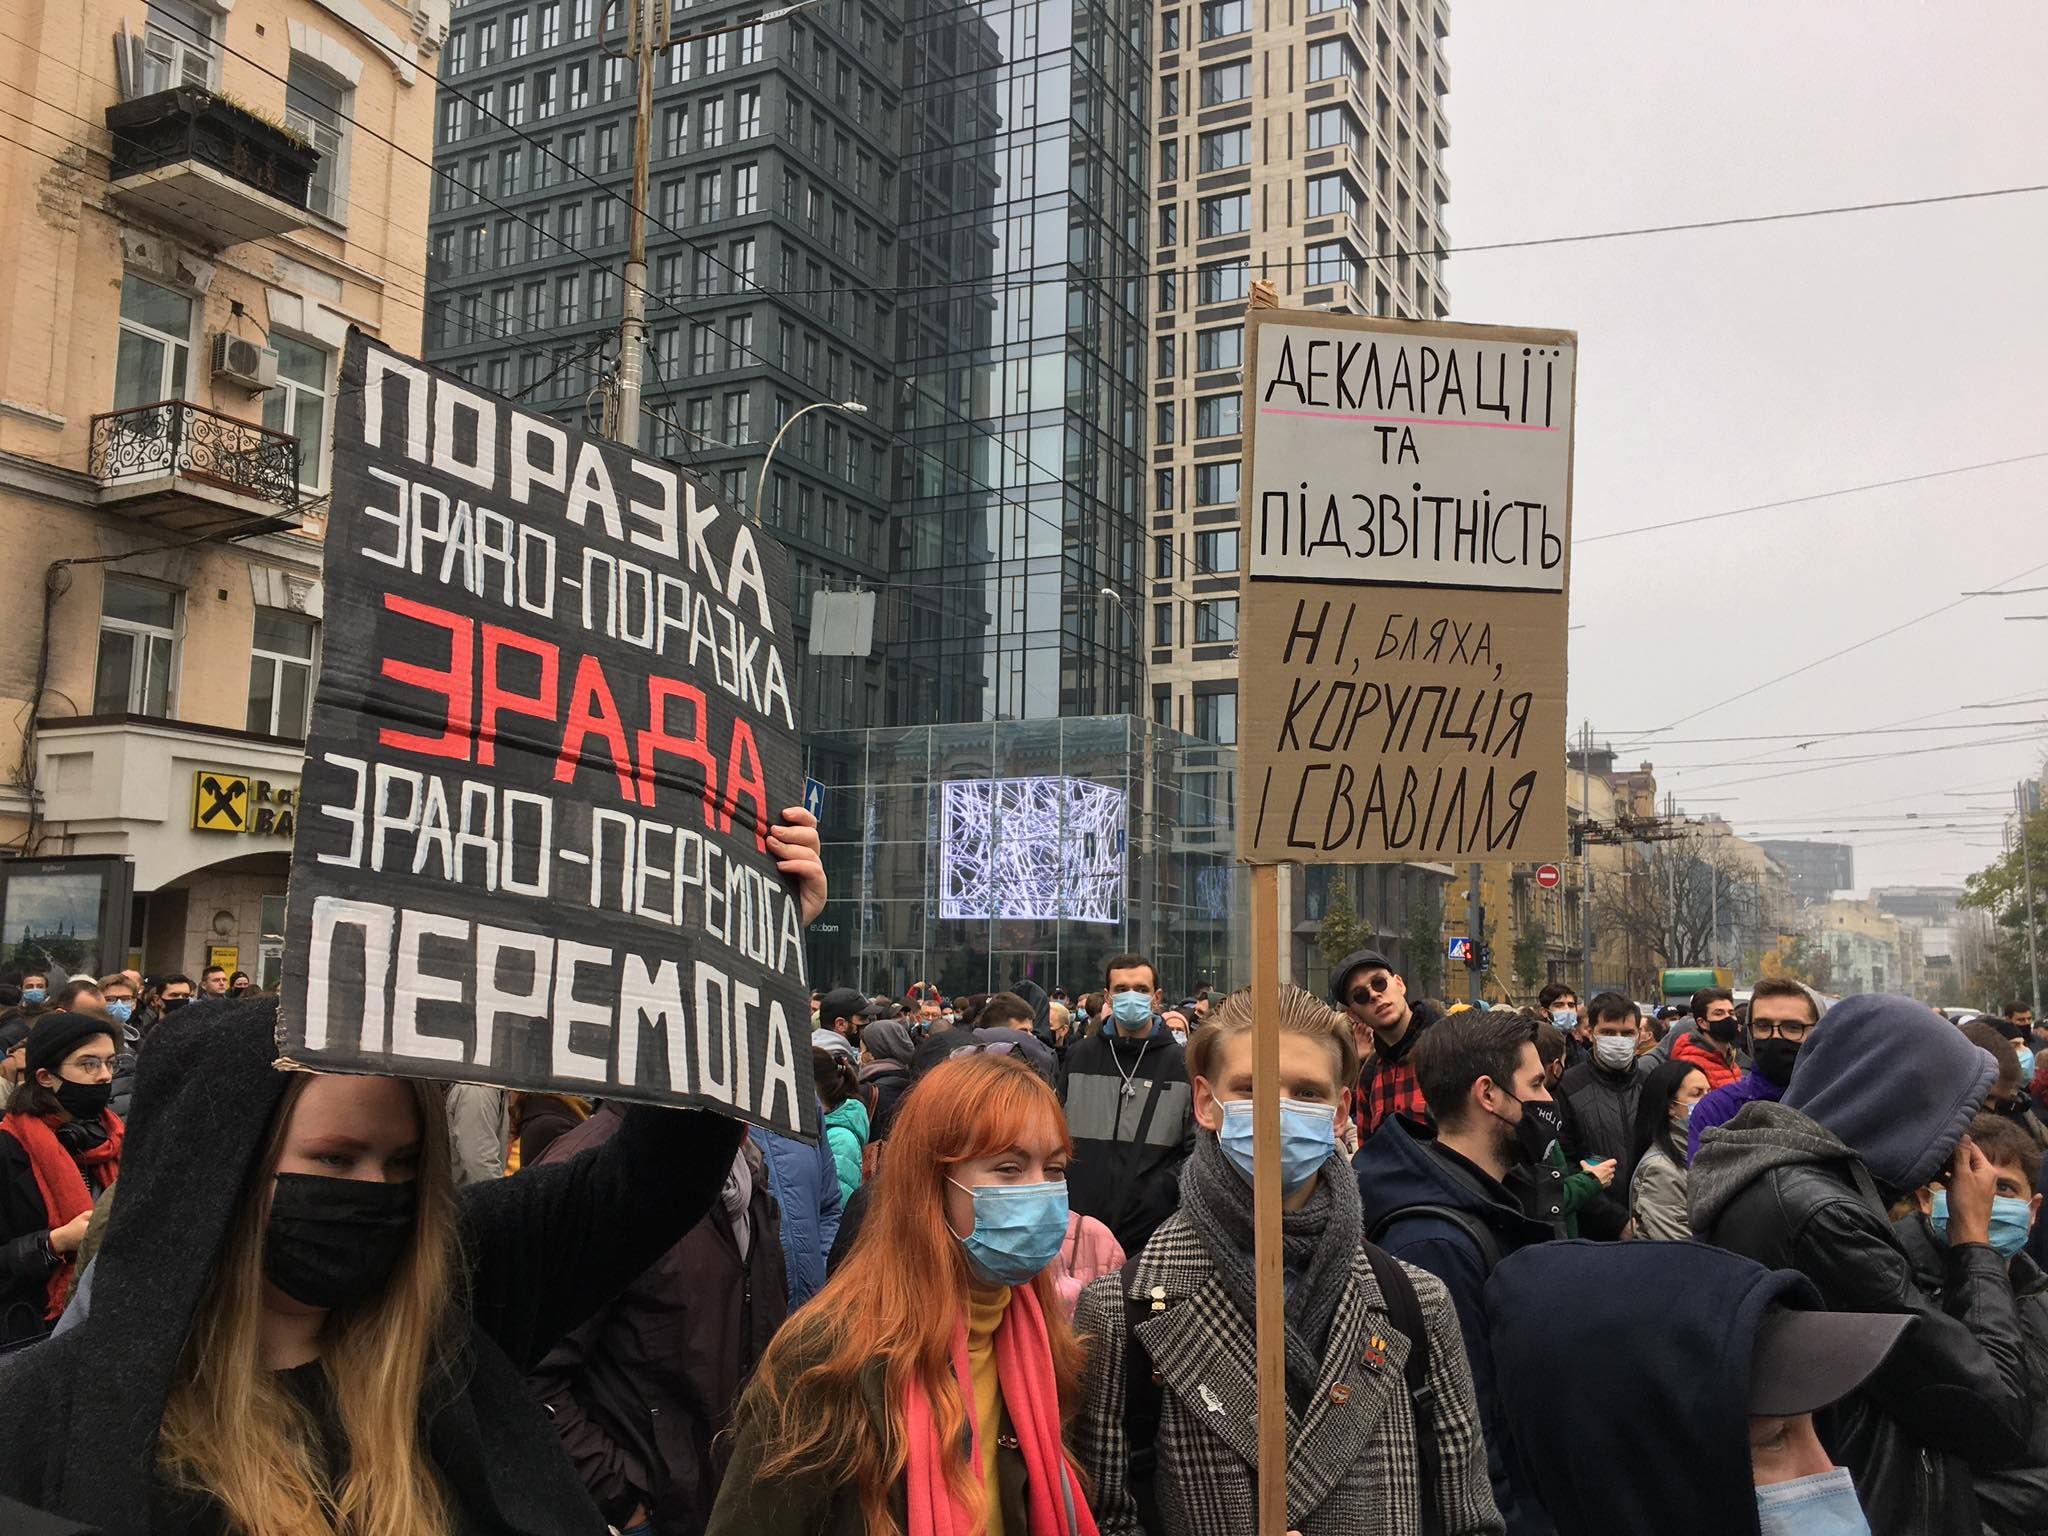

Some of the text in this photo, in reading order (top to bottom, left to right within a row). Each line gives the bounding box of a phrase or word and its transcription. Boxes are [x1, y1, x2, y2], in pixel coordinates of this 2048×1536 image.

[1265, 335, 1560, 428] ДЕКЛАРАЦІЇ
[1374, 426, 1419, 464] ТА
[364, 346, 775, 634] ПОРАЗКА
[1261, 482, 1561, 569] ПІДЗВІТНІСТЬ
[1283, 599, 1503, 682] НІ, БЛЯХА,
[379, 592, 767, 854] ЗРАДА
[1277, 678, 1533, 759] КОРУПЦІЯ
[250, 807, 293, 834] BA
[251, 780, 299, 804] Ra
[1287, 763, 1538, 853] СВАВІЛЛЯ
[317, 752, 806, 986] ЗРАДО-ПЕРЕМОГА
[304, 896, 801, 1131] ПЕРЕМОГА
